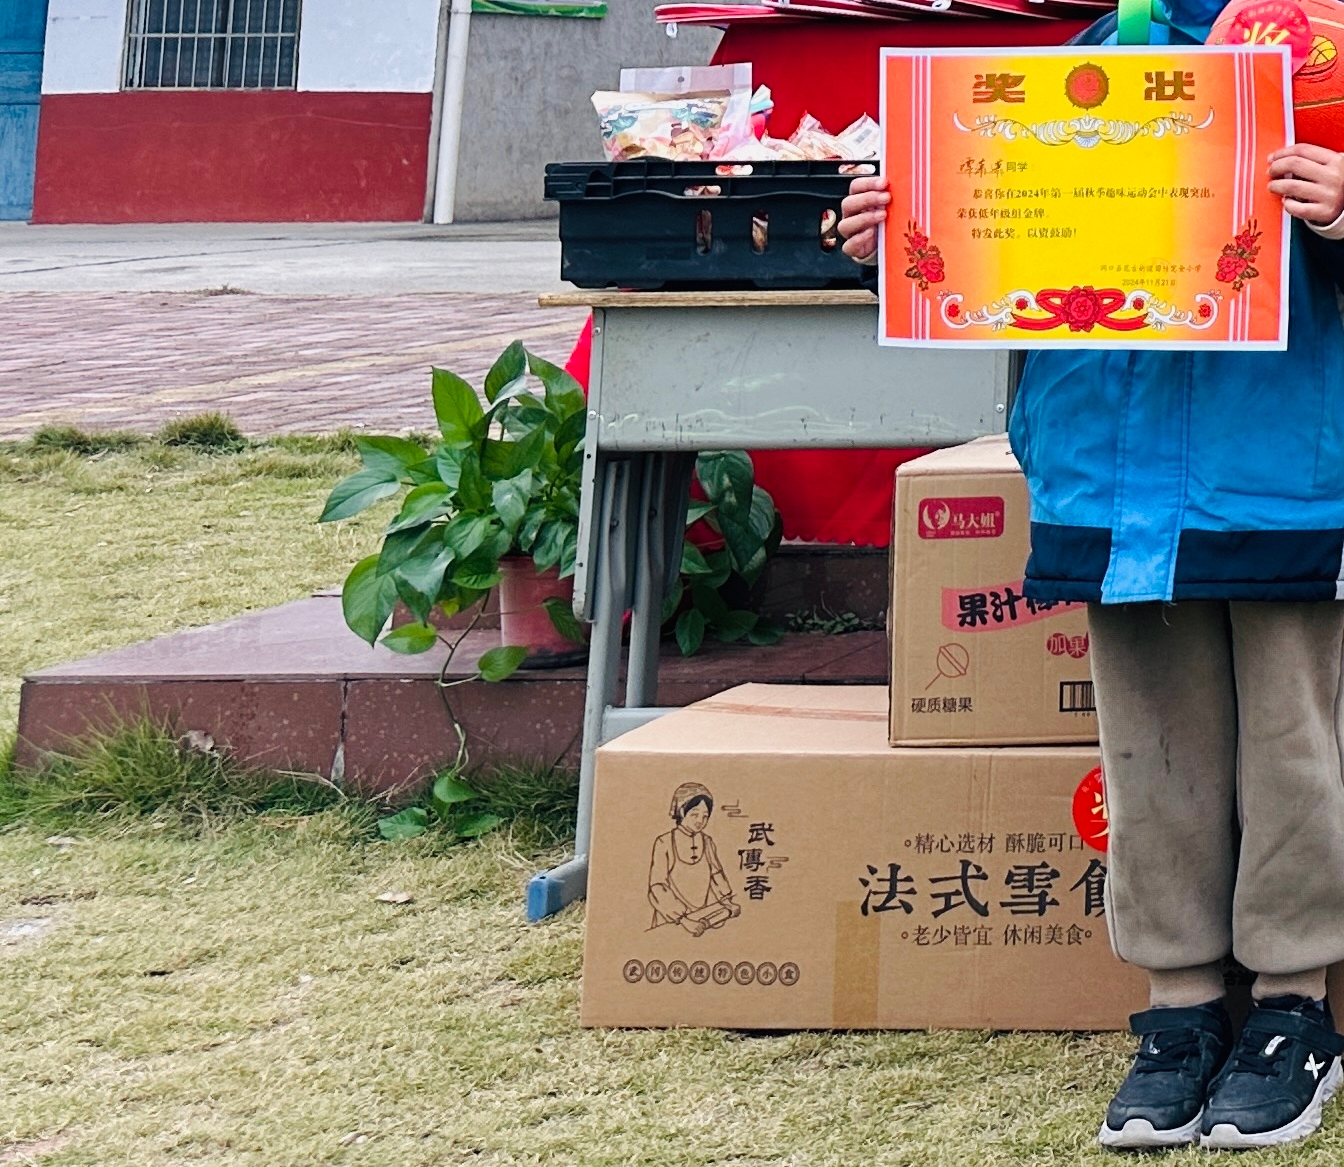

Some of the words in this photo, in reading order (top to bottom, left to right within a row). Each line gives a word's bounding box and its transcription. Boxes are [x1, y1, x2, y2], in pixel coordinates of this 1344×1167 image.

[952, 512, 996, 530] 马大姐
[910, 697, 974, 714] 硬质糖果
[913, 832, 996, 855] 精心选材
[1004, 832, 1084, 854] 酥脆可口
[911, 924, 993, 947] 老少皆宜
[1003, 922, 1085, 946] 休闲美食
